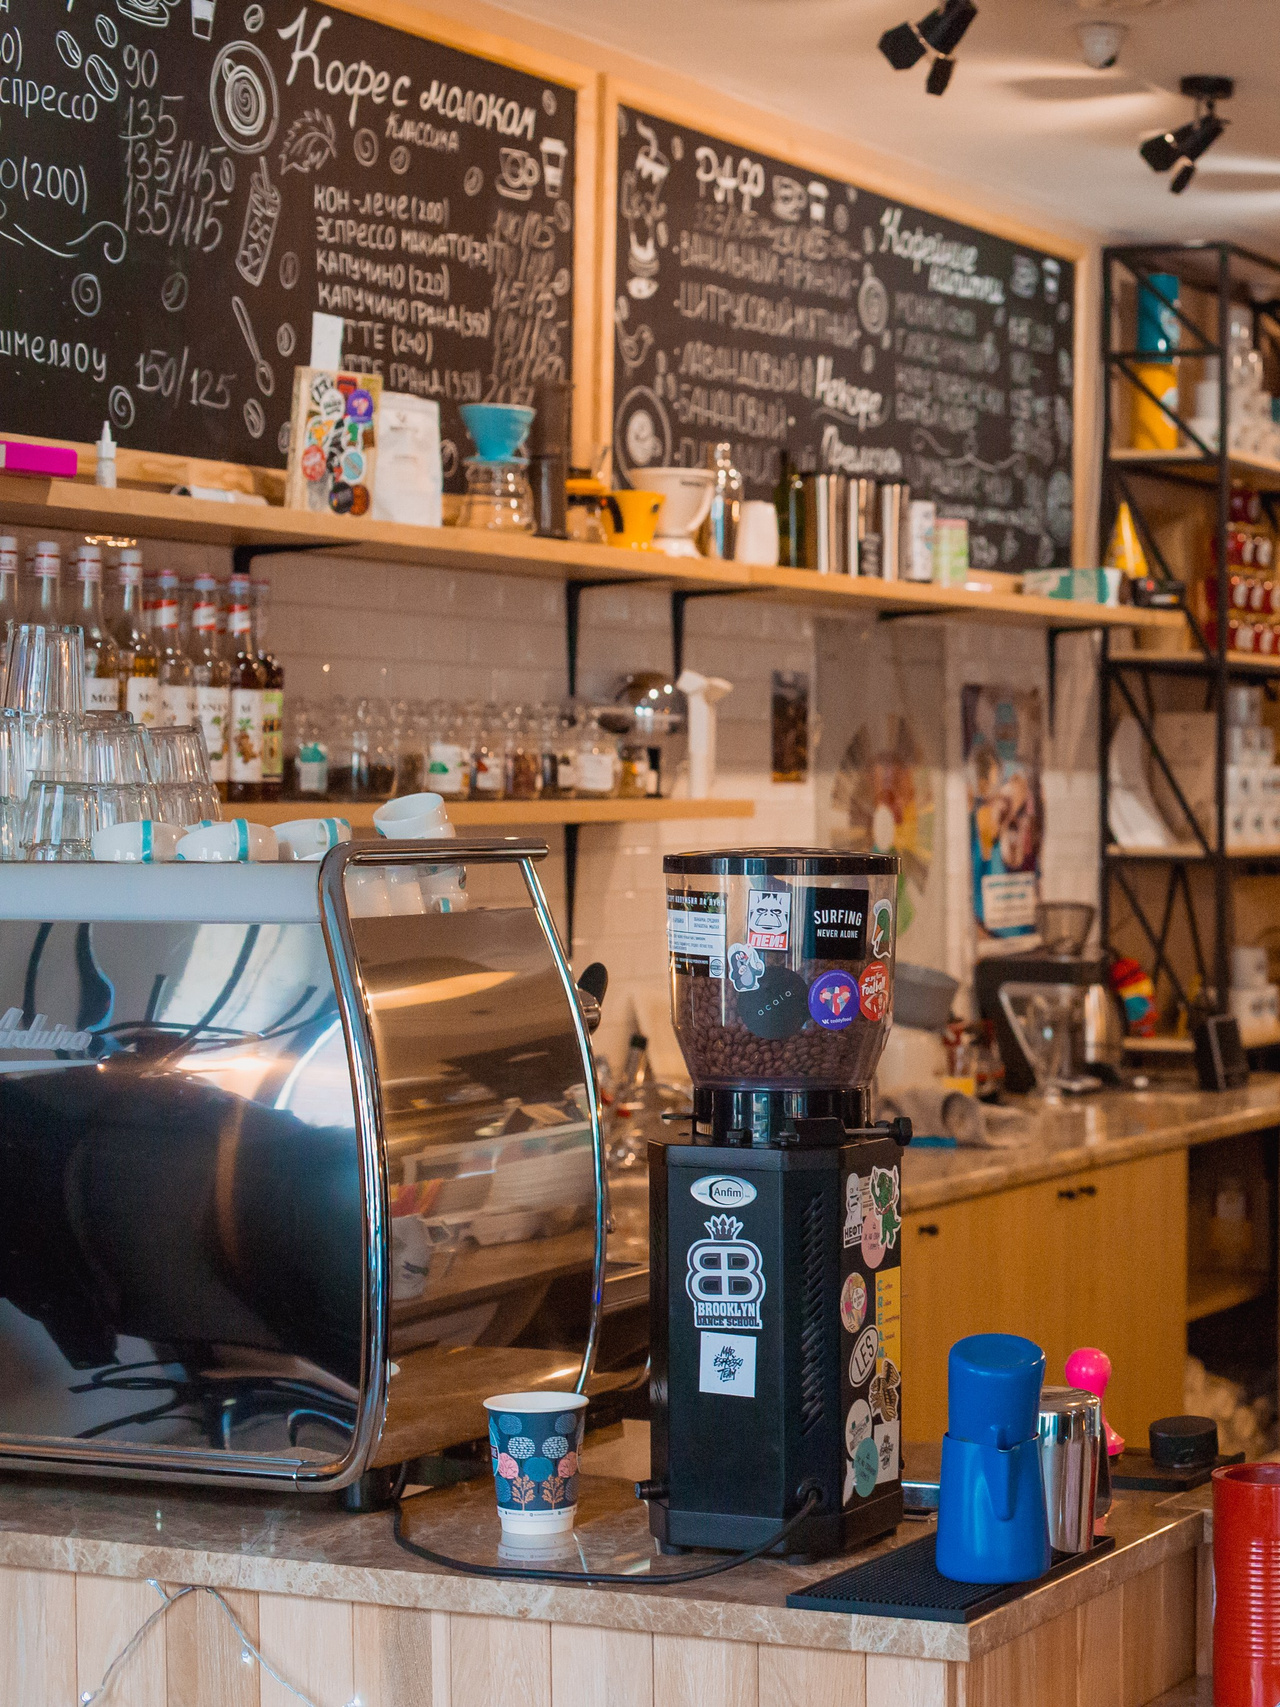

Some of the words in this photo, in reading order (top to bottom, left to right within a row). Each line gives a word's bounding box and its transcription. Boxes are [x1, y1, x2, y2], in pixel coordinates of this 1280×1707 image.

[123, 44, 158, 89] 90
[344, 318, 386, 351] ТТЕ
[813, 909, 863, 926] SURFING
[816, 928, 838, 938] NEVER
[839, 929, 859, 939] ALONE
[713, 1182, 742, 1198] Anfim
[697, 1301, 757, 1317] BROOKLYN
[696, 1317, 725, 1327] DANCE
[726, 1317, 760, 1328] SCHOOL
